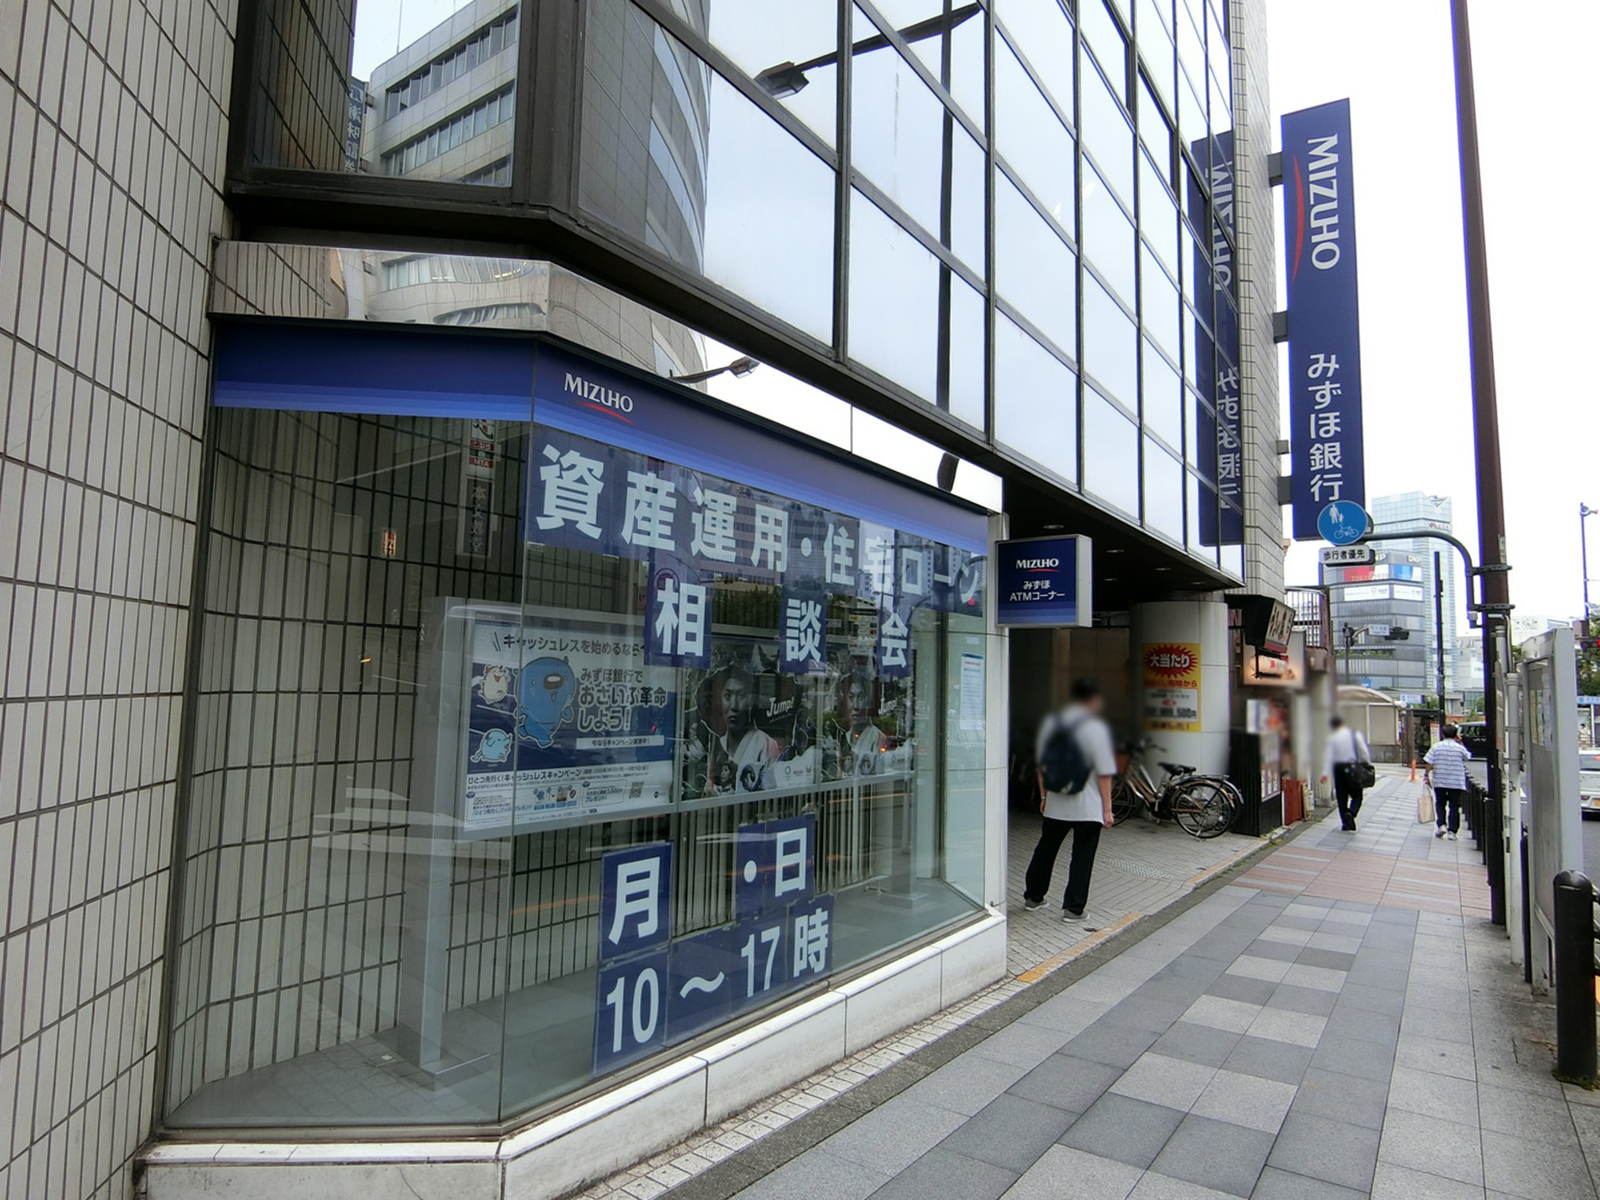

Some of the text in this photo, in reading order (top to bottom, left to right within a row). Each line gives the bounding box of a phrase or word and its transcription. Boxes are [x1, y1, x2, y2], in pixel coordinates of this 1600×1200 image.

[1307, 134, 1340, 270] MIZUHO
[564, 372, 634, 413] MIZUHO
[1307, 353, 1344, 502] みずほ銀行
[536, 444, 980, 605] 資産運用・住宅ローン
[1323, 548, 1366, 561] 歩行者優先
[1015, 558, 1060, 569] MIZUHO
[1023, 580, 1051, 590] みずほ
[1009, 591, 1066, 602] ATMコーナー
[1150, 653, 1190, 668] 大当たり
[580, 668, 643, 683] みずほ銀行で
[578, 686, 667, 707] おさいふ革命
